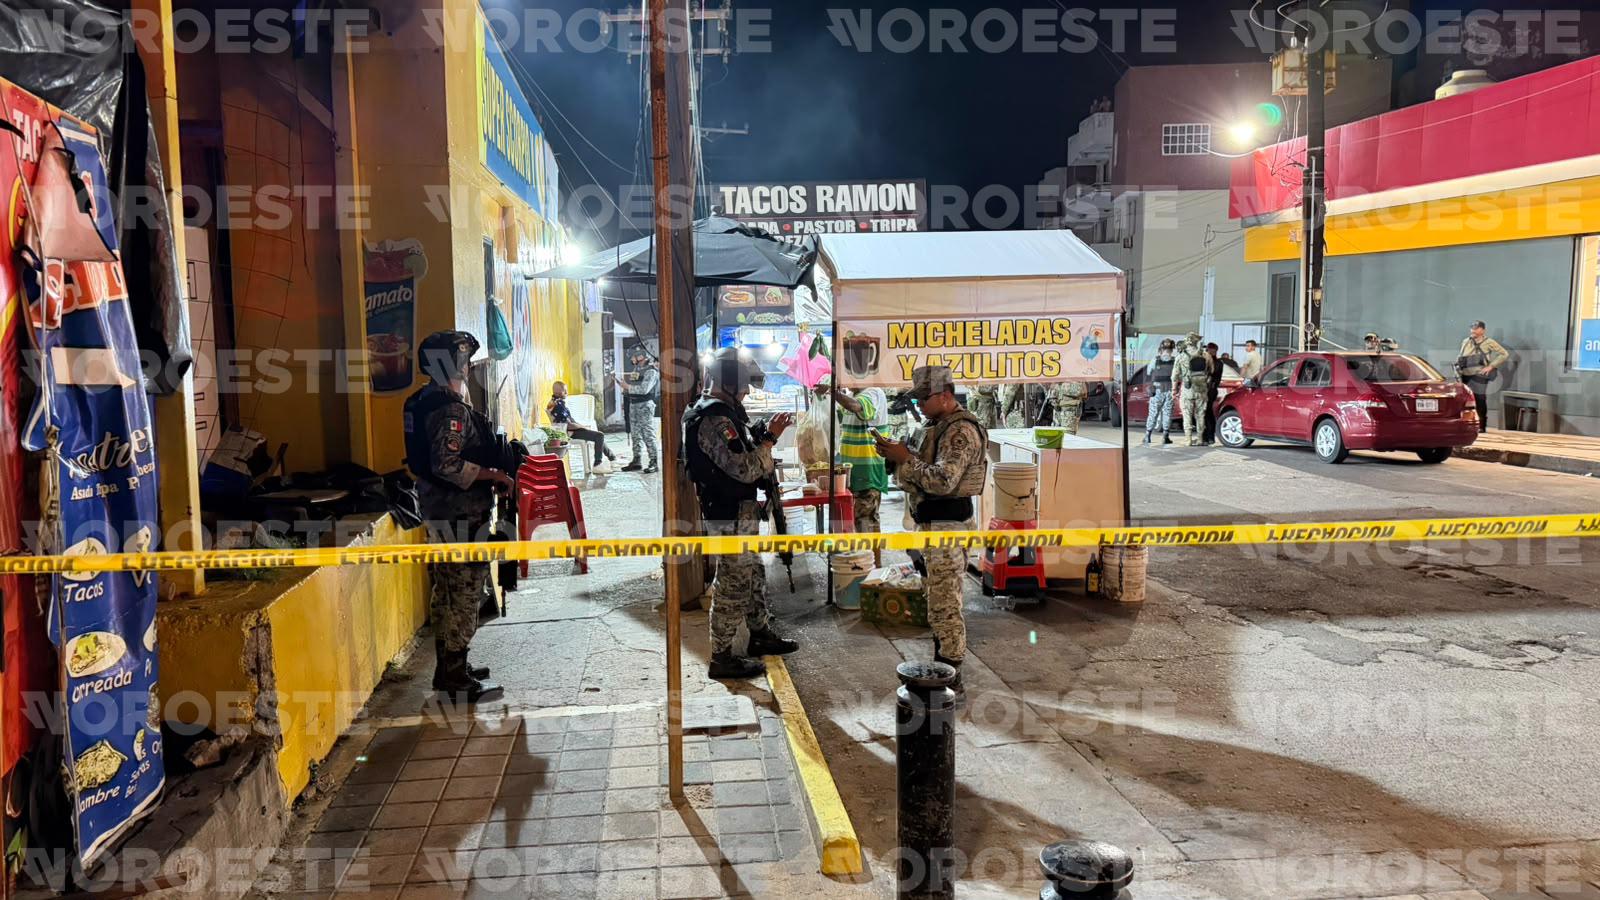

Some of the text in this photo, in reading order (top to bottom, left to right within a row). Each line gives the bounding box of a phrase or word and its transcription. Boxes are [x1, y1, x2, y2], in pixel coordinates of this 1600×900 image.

[720, 183, 916, 215] TACOS RAMON
[794, 219, 856, 234] PASTOR
[870, 218, 918, 232] TRIPA
[887, 318, 1072, 349] MICHELADAS
[897, 350, 1062, 381] Y AZULITOS
[64, 581, 104, 603] Tacos
